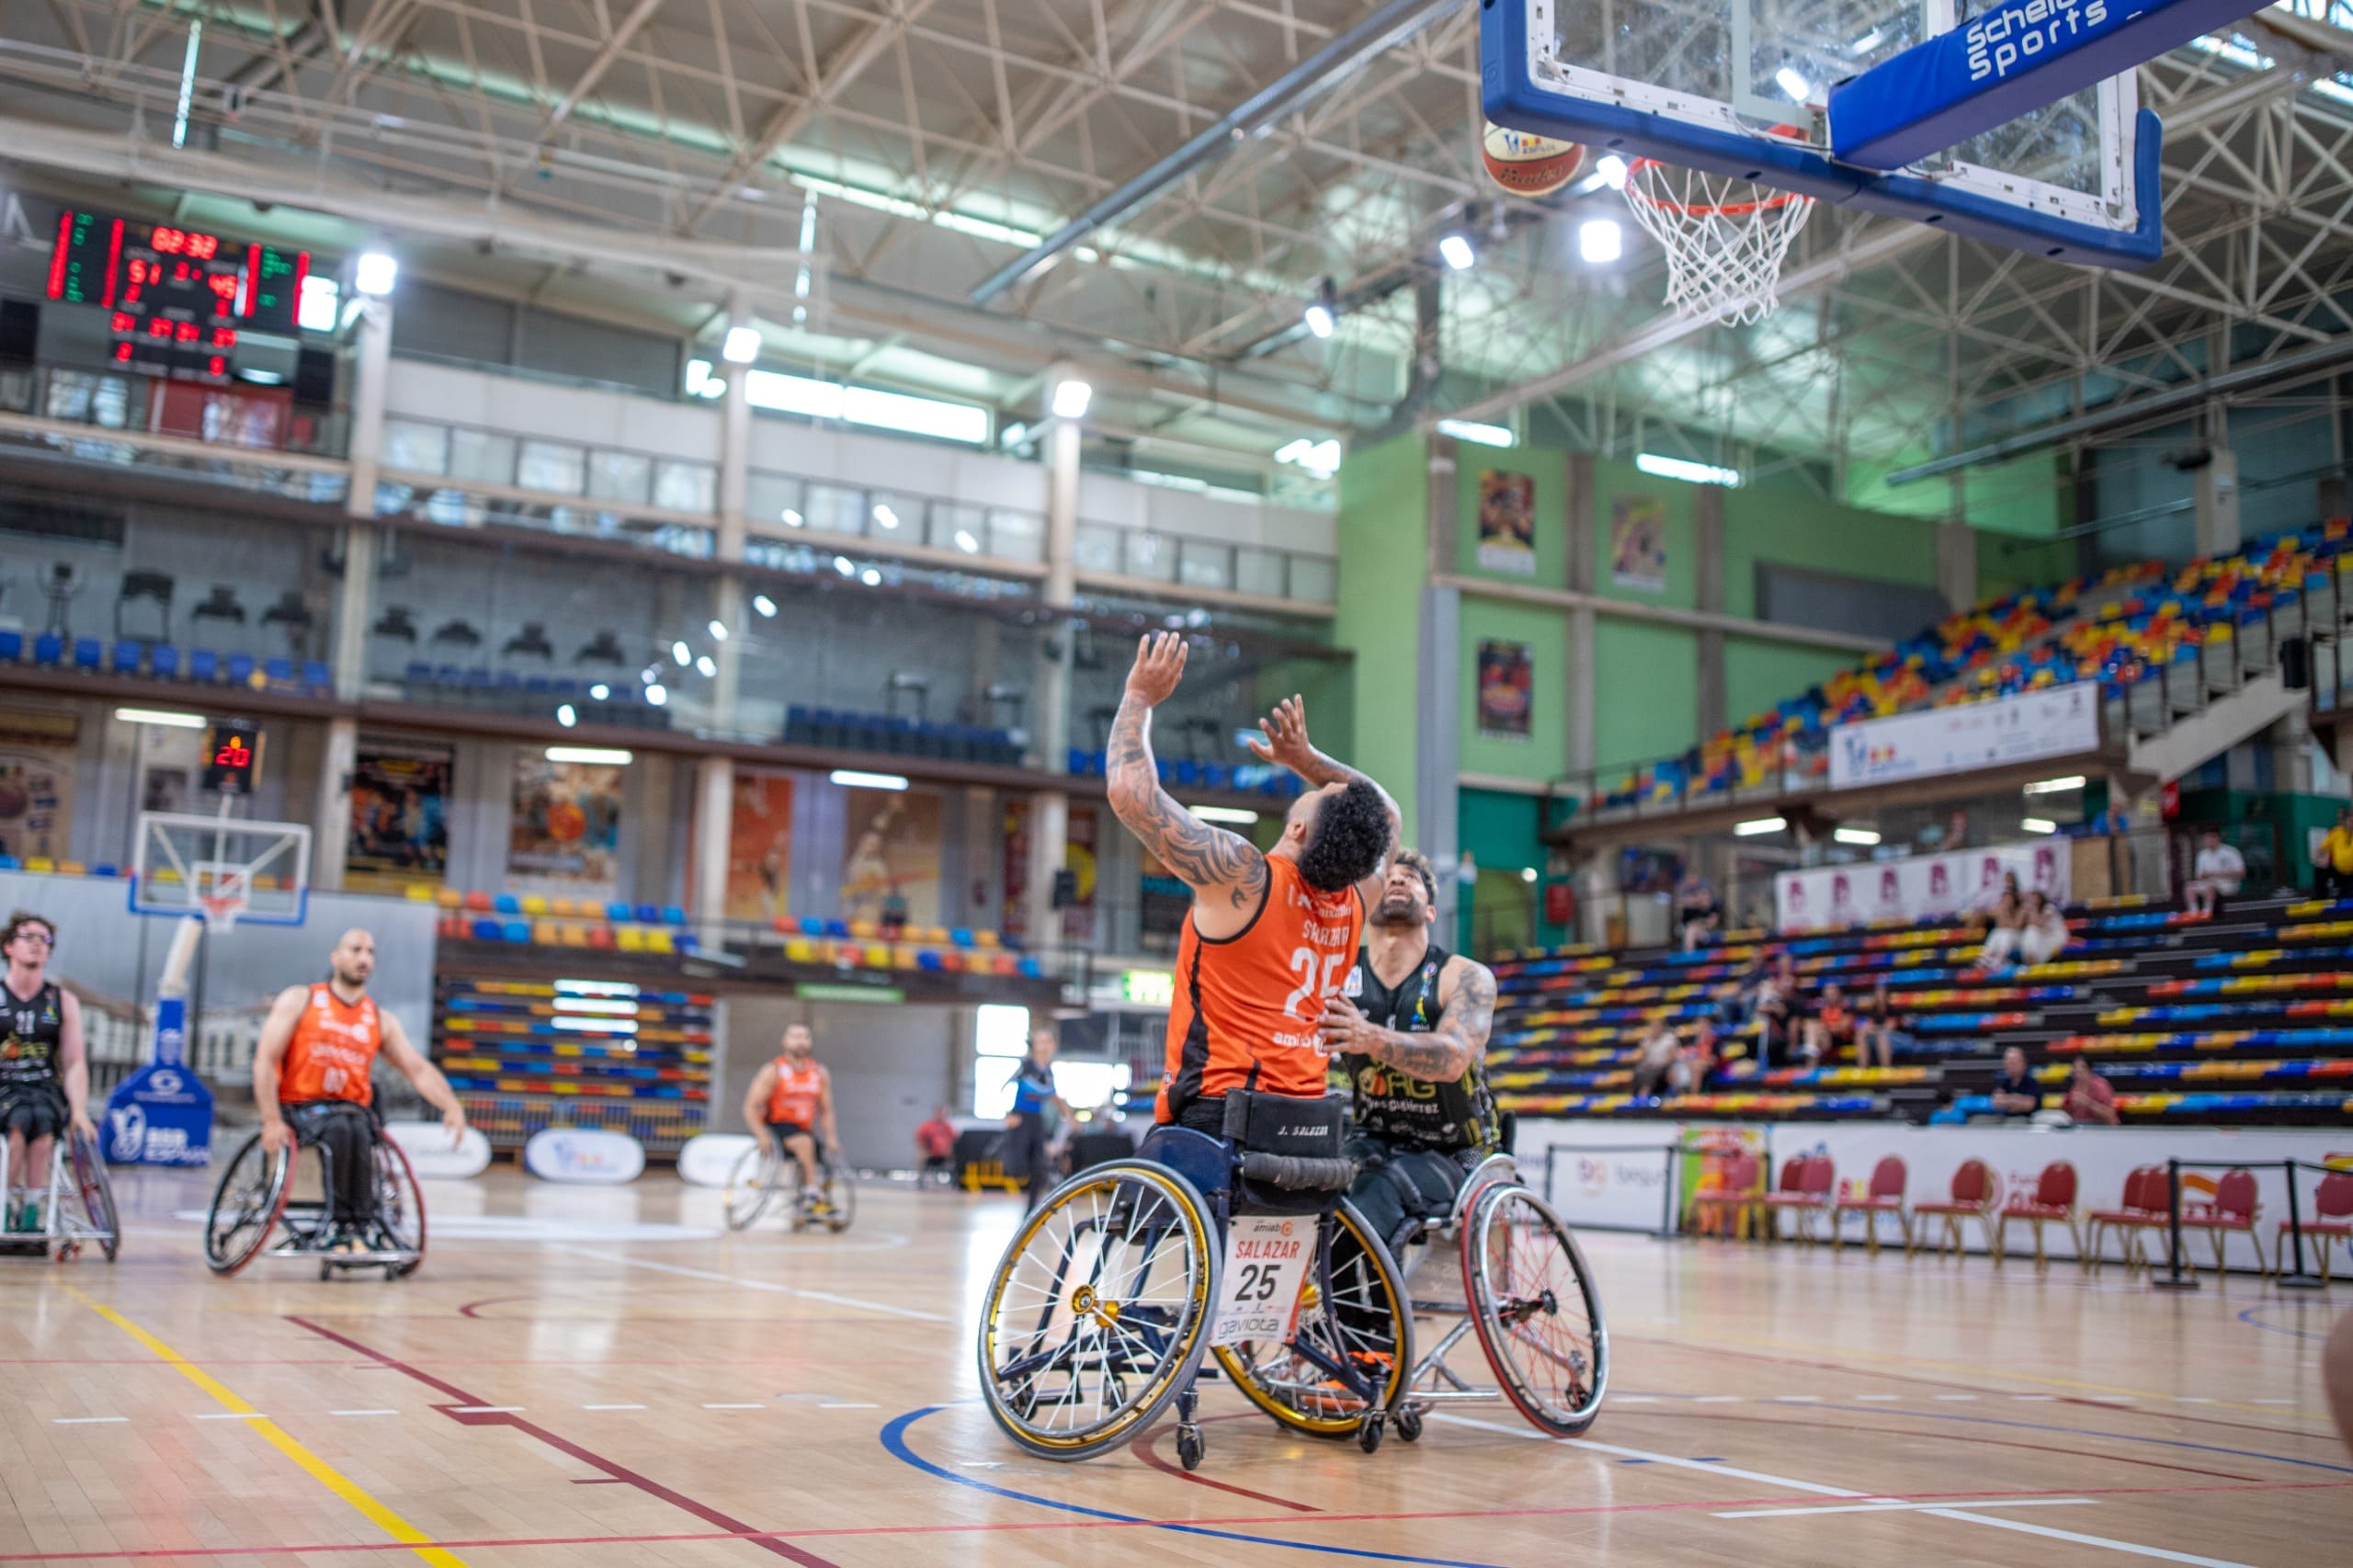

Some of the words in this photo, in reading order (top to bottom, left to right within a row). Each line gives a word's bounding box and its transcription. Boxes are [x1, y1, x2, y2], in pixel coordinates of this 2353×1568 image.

[1968, 0, 2108, 81] Sports
[215, 745, 251, 767] 20
[1283, 946, 1346, 1023] 25
[1235, 1241, 1301, 1258] SALAZAR
[1234, 1264, 1281, 1301] 25
[1218, 1318, 1279, 1339] gaviota
